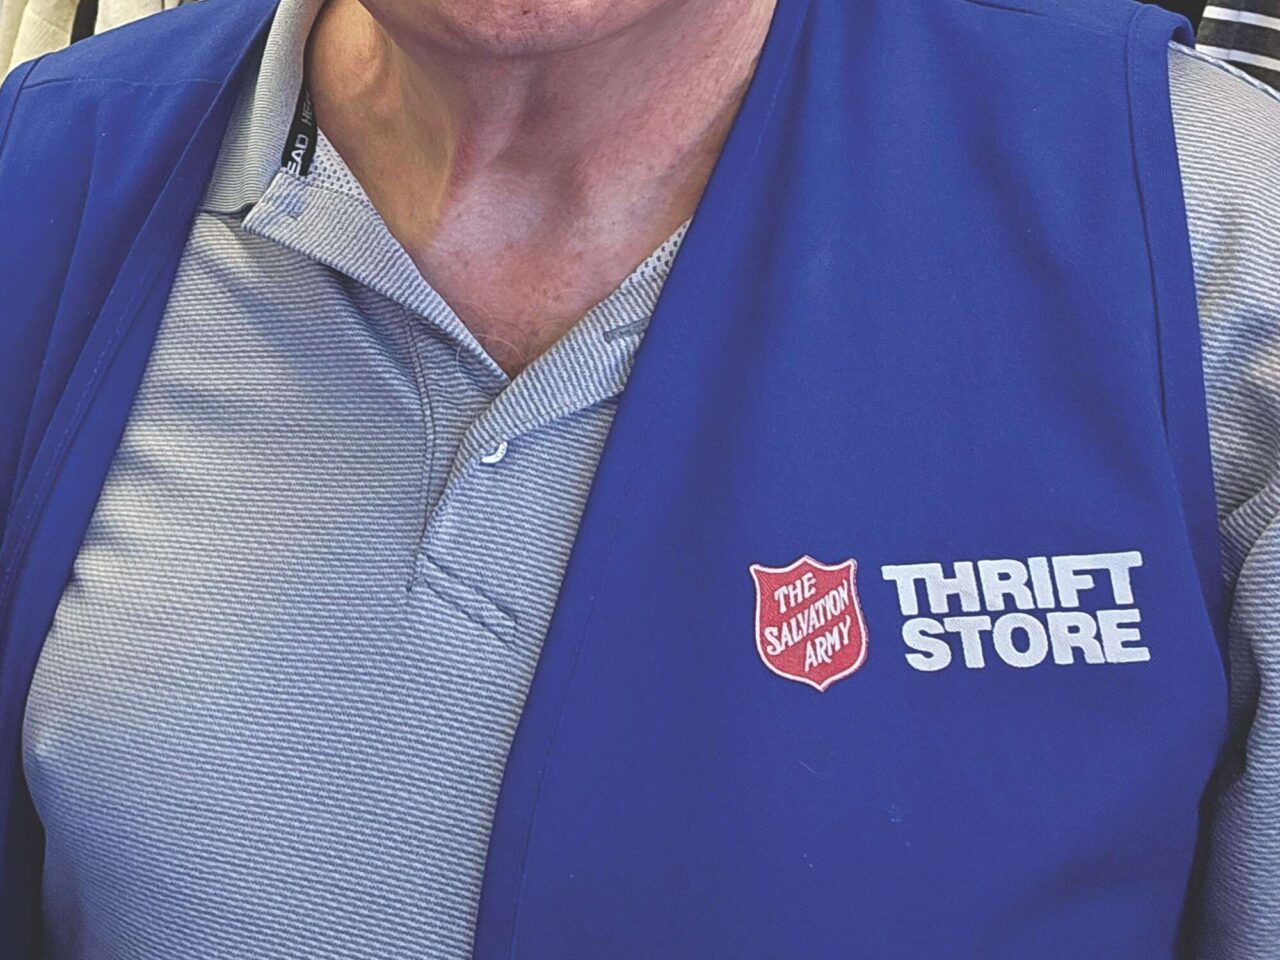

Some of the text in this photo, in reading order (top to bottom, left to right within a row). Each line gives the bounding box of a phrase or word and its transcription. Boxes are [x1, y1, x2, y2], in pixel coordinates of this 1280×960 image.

[773, 571, 817, 615] THE
[880, 550, 1144, 617] THRIFT
[764, 578, 850, 656] SALVATION
[804, 613, 852, 673] ARMY
[901, 608, 1152, 672] STORE
